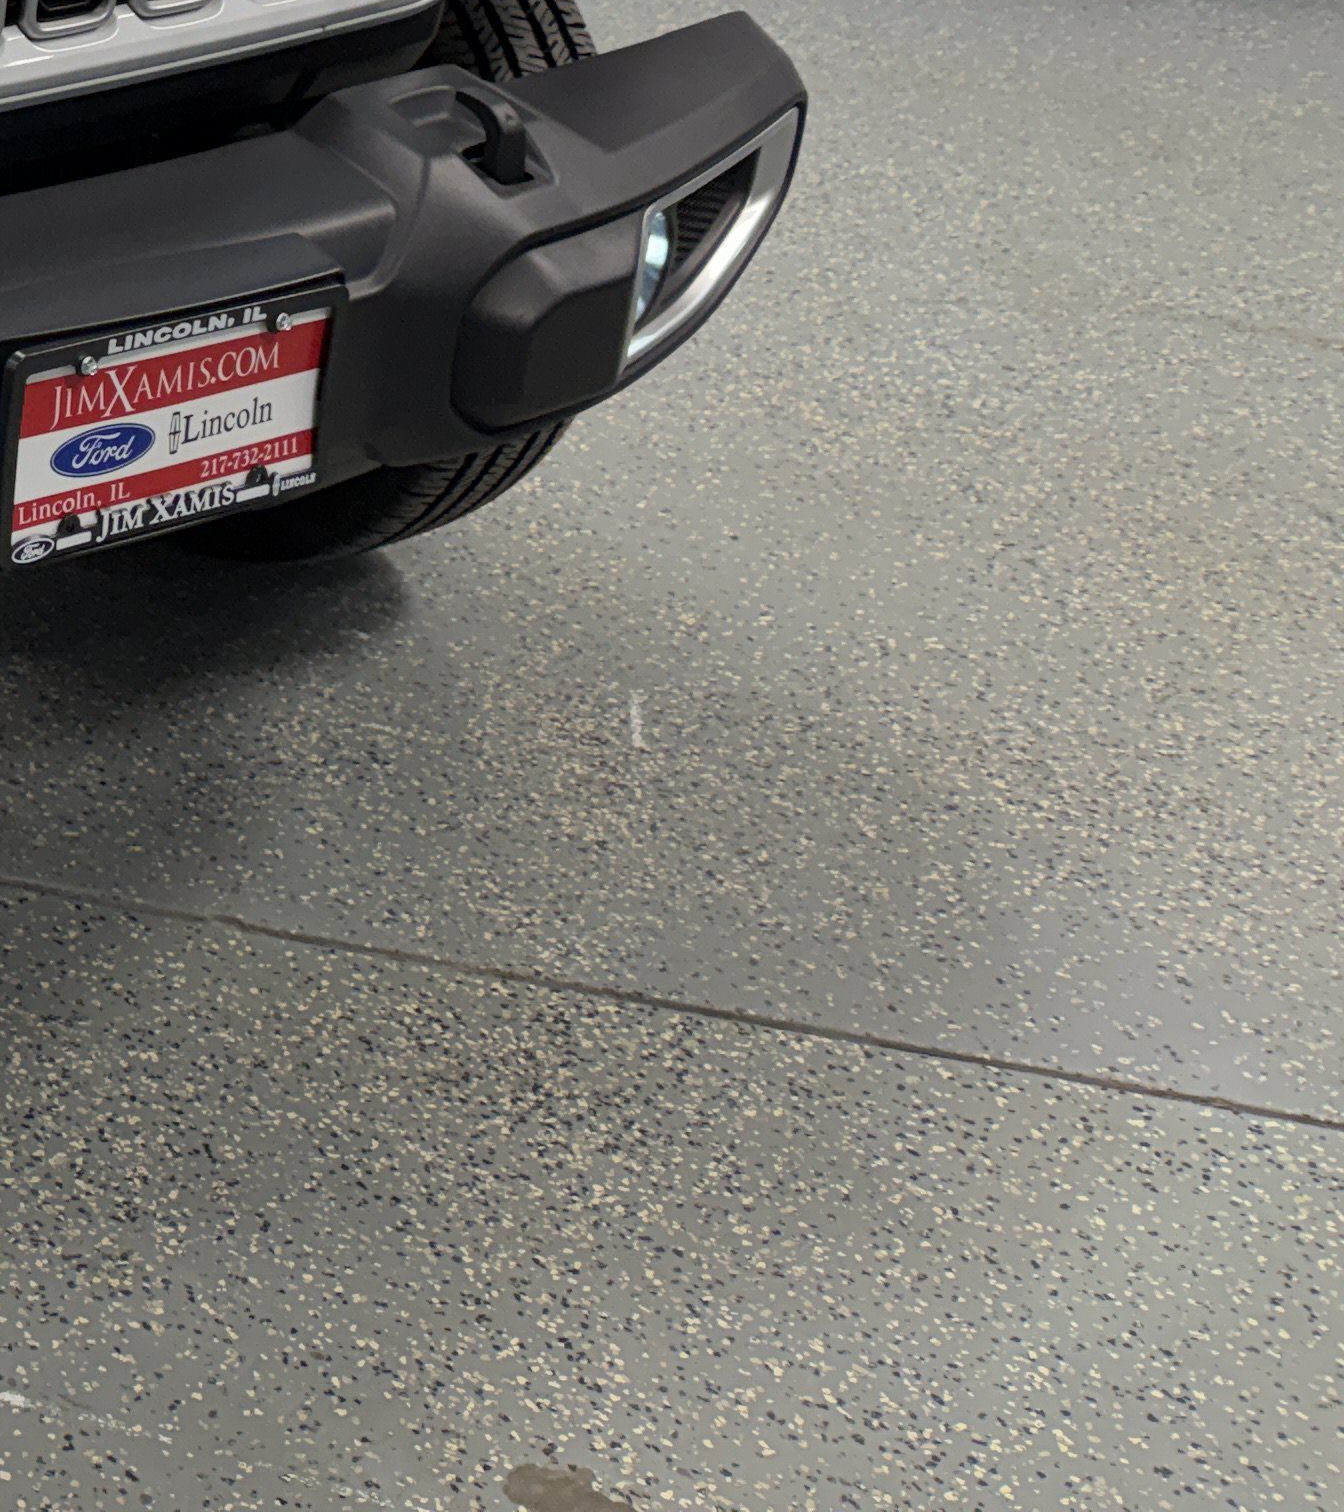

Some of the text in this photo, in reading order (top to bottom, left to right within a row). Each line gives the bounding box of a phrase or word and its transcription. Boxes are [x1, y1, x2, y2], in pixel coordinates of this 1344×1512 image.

[108, 306, 267, 355] LINCOLN, IL
[50, 342, 280, 430] JIMXAMIS.COM
[182, 396, 273, 445] Lincoln
[71, 431, 136, 469] Ford
[201, 437, 298, 478] 217-732-2111
[18, 482, 131, 525] Lincoln, IL
[96, 483, 236, 542] JIM XAMIS
